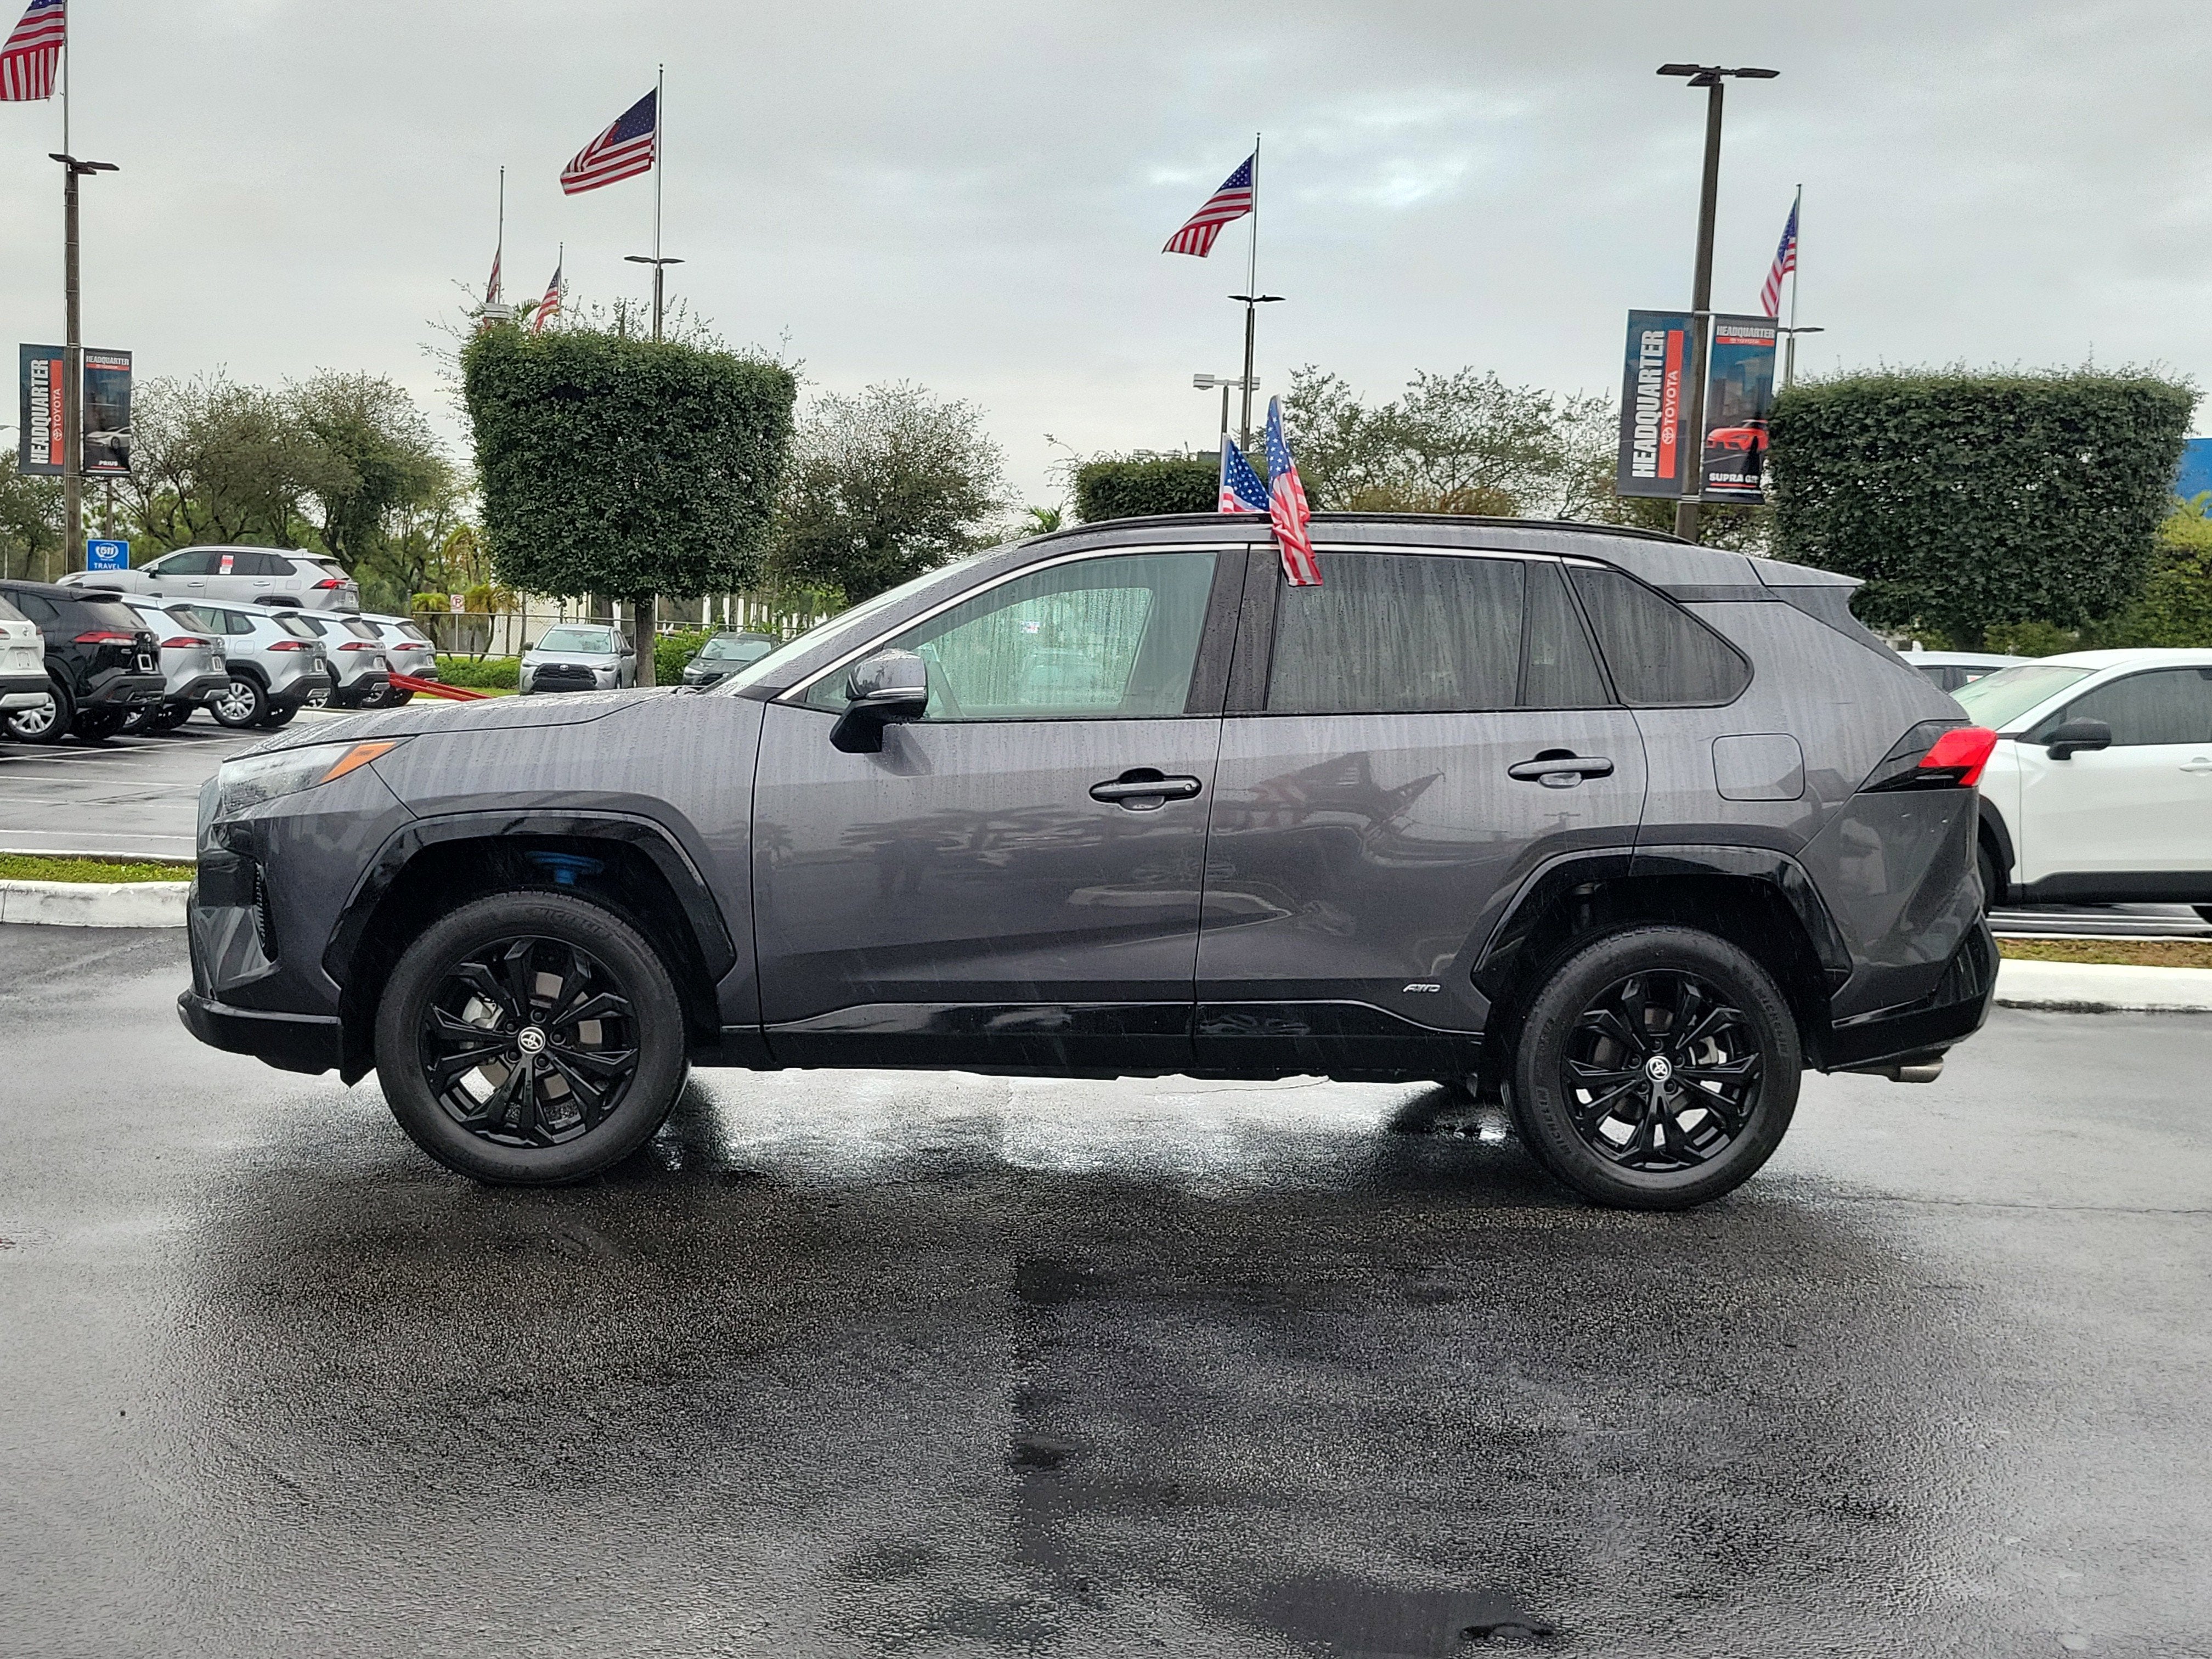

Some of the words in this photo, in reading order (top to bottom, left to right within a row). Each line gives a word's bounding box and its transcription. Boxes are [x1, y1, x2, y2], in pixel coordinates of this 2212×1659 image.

[30, 359, 51, 464] HEADQUARTER
[53, 388, 61, 428] TOYOTA
[1632, 330, 1664, 478] HEADQUARTER
[1663, 370, 1679, 425] TOYOTA
[1709, 472, 1744, 482] SUPRA
[100, 546, 114, 555] 511
